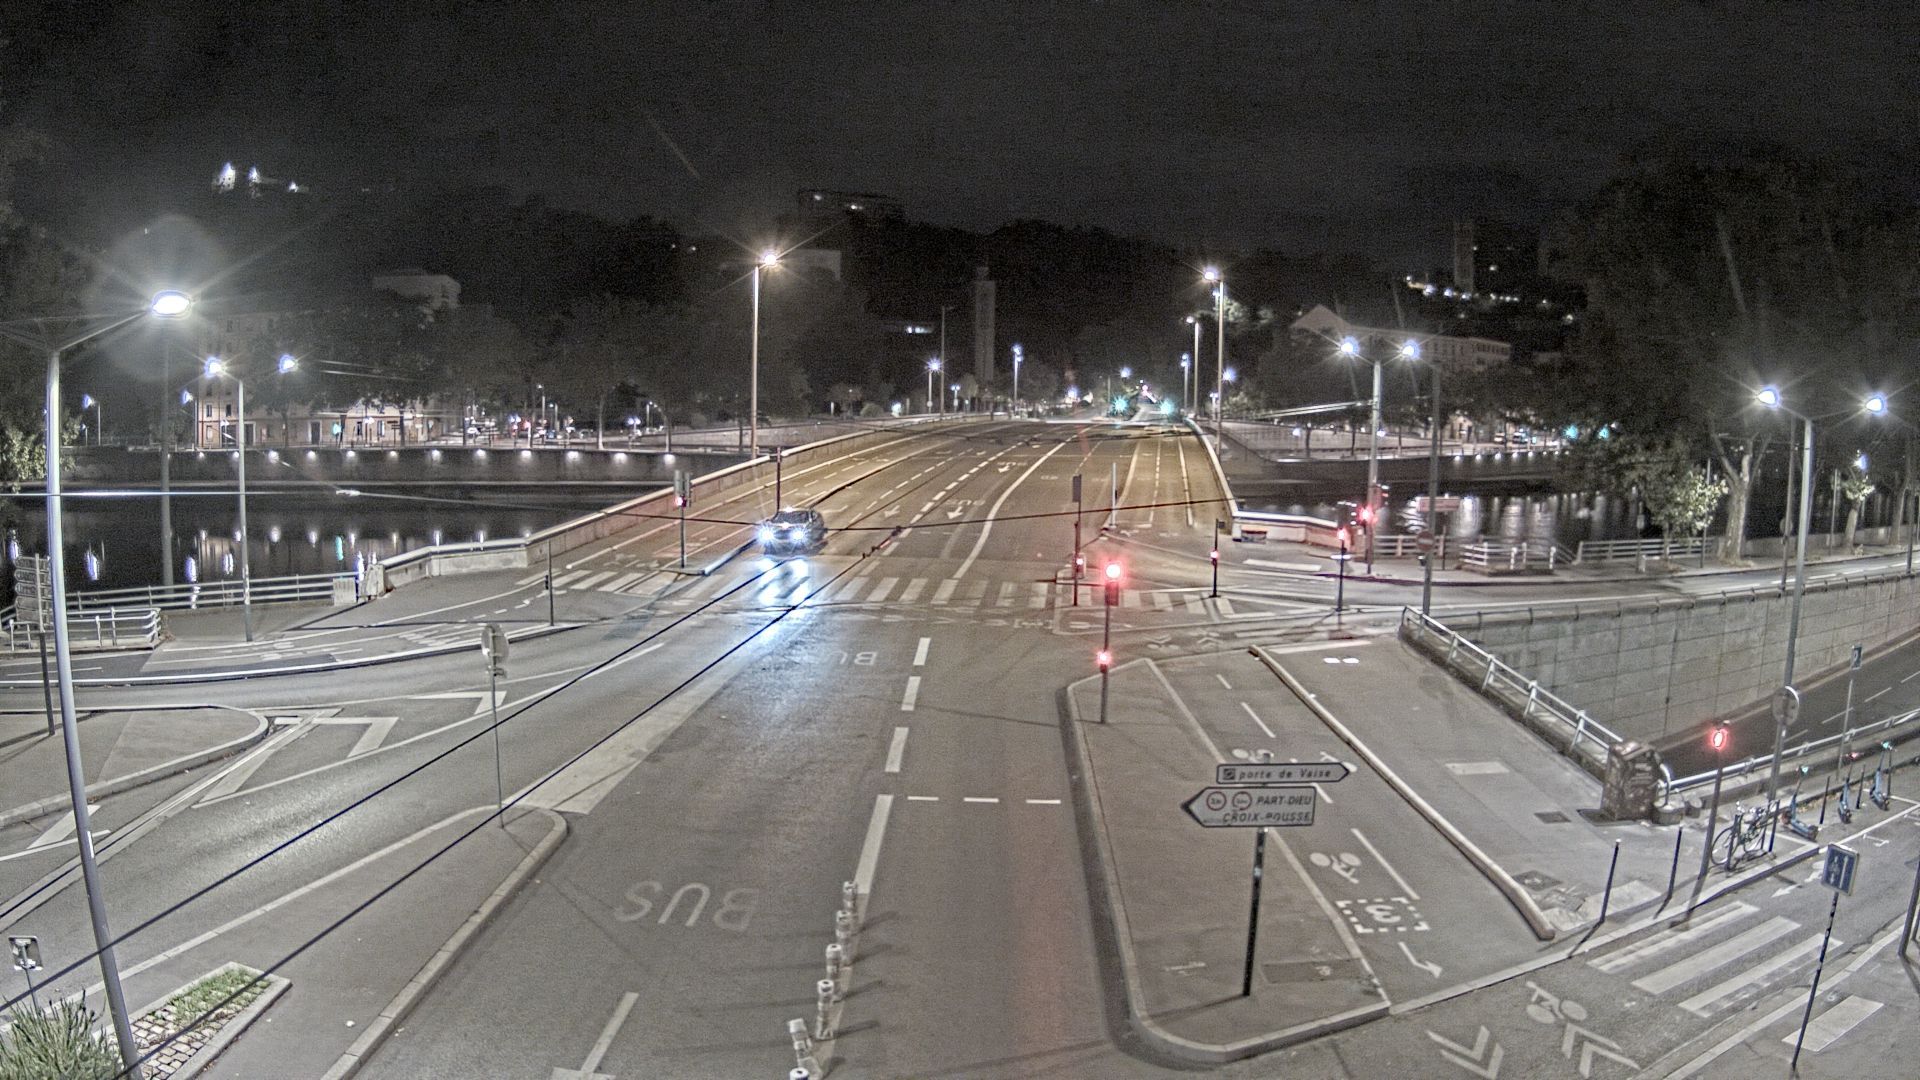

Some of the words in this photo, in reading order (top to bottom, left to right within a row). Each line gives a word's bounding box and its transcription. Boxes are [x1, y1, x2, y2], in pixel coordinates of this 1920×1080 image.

[829, 650, 878, 666] BU
[1237, 768, 1273, 781] porte
[1279, 767, 1293, 779] de
[1299, 766, 1332, 779] Vaise
[1255, 795, 1312, 806] PART-DIEU
[613, 880, 759, 932] BUS
